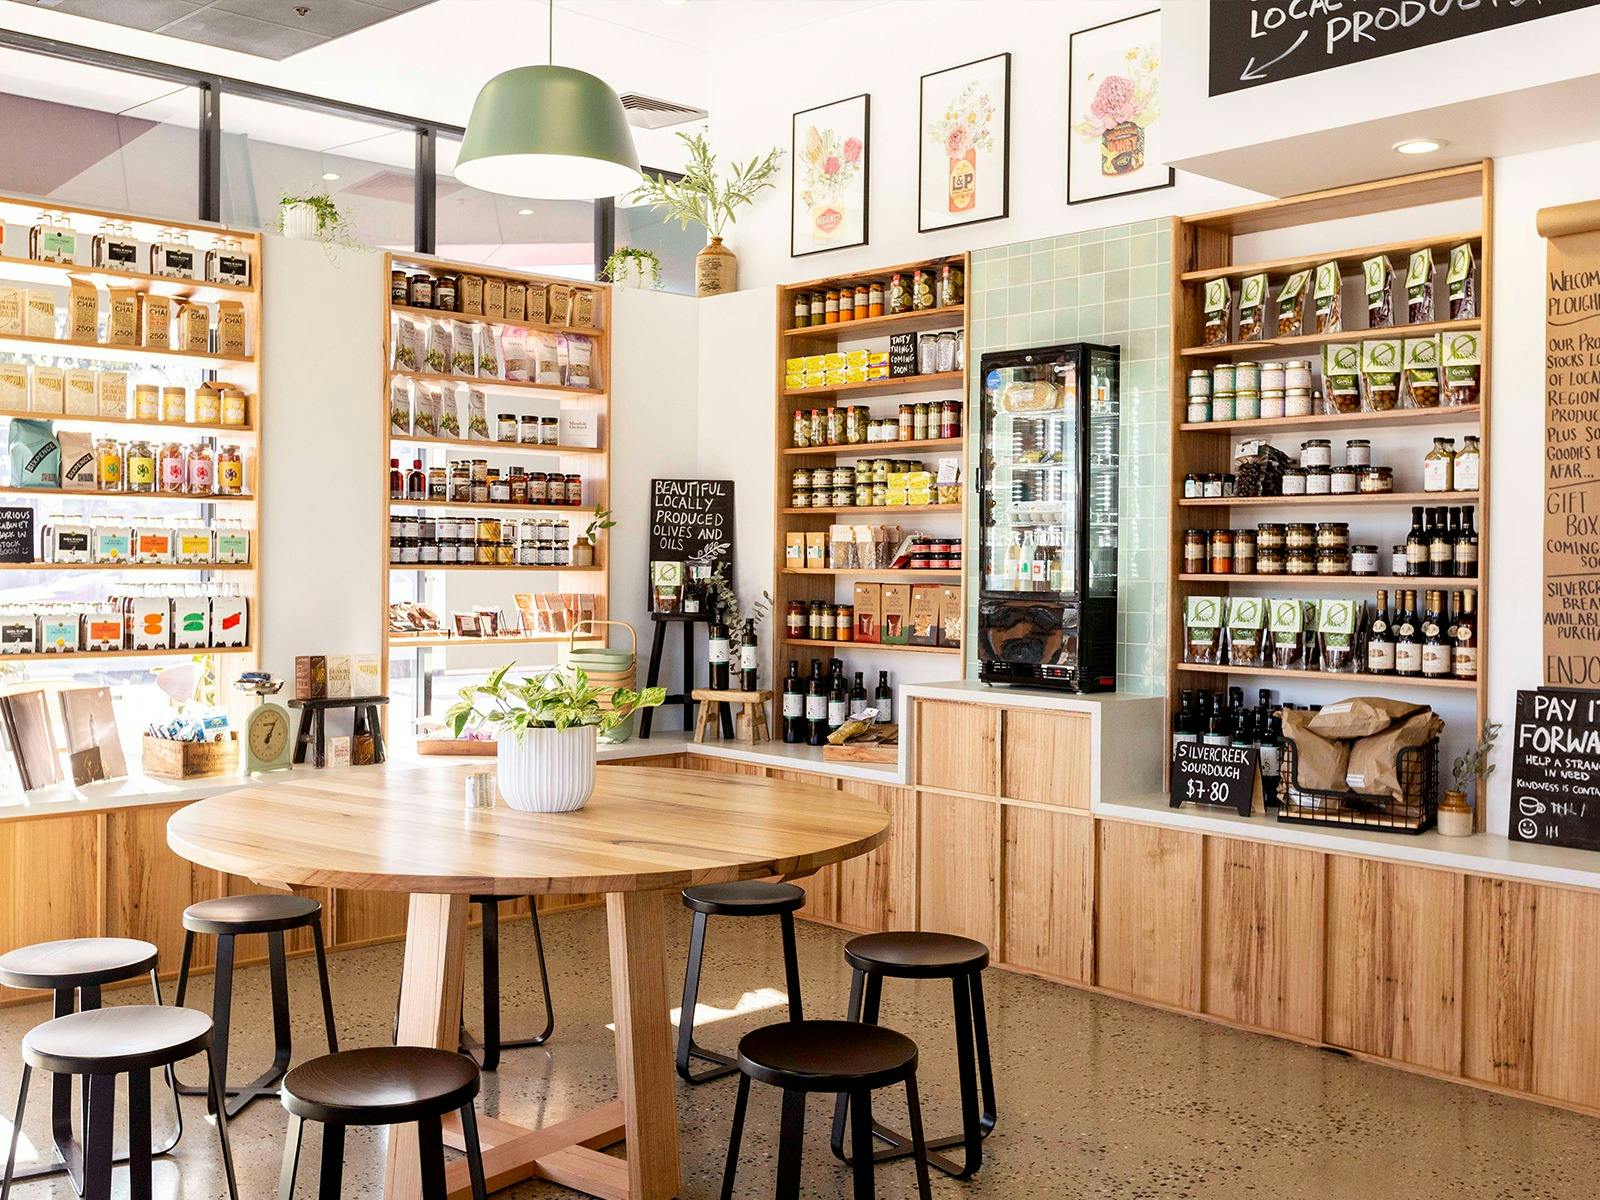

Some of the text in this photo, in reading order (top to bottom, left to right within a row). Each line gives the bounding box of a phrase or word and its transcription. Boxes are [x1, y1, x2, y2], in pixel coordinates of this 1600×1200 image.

[1327, 0, 1521, 54] PRODU
[952, 173, 974, 190] L&P
[1549, 270, 1600, 291] WELCOM
[77, 300, 95, 308] CHAI
[115, 304, 133, 313] CHAI
[1548, 293, 1600, 316] PLOUGH
[891, 335, 911, 344] TASTY
[1549, 338, 1575, 351] OUR
[891, 343, 914, 354] THINGS
[891, 354, 914, 363] COMING
[1547, 353, 1584, 369] STOCKS
[1549, 370, 1600, 386] OF LOCA
[1548, 388, 1600, 406] REGION
[1552, 408, 1600, 423] PRODUC
[1547, 427, 1577, 442] PLUS
[27, 442, 55, 472] SIXPENCE
[1547, 446, 1591, 461] GOODIES
[68, 454, 92, 478] SIXPENCE
[655, 481, 726, 497] BEAUTIFUL
[655, 495, 714, 512] LOCALLY
[1547, 491, 1587, 514] GIFT
[0, 511, 30, 519] URIOUS
[656, 510, 723, 527] PRODUCED
[0, 521, 28, 530] ABINET
[653, 524, 723, 540] OLIVES AND
[0, 541, 20, 549] TOCK
[660, 537, 683, 550] OILS
[1546, 539, 1600, 555] COMING
[1581, 555, 1600, 569] SO
[1562, 597, 1600, 610] BREA
[1544, 612, 1600, 627] AVAILABL
[1547, 655, 1600, 684] ENJO
[1535, 695, 1600, 722] PAY I
[1519, 724, 1600, 755] FORWA
[1179, 744, 1250, 766] SILVERCREEK
[1526, 754, 1600, 771] HELP A STRAN
[1181, 760, 1240, 780] SOURDOUGH
[1544, 769, 1590, 781] IN NEED
[1516, 778, 1559, 793] KINDNESS
[1562, 784, 1569, 792] IS
